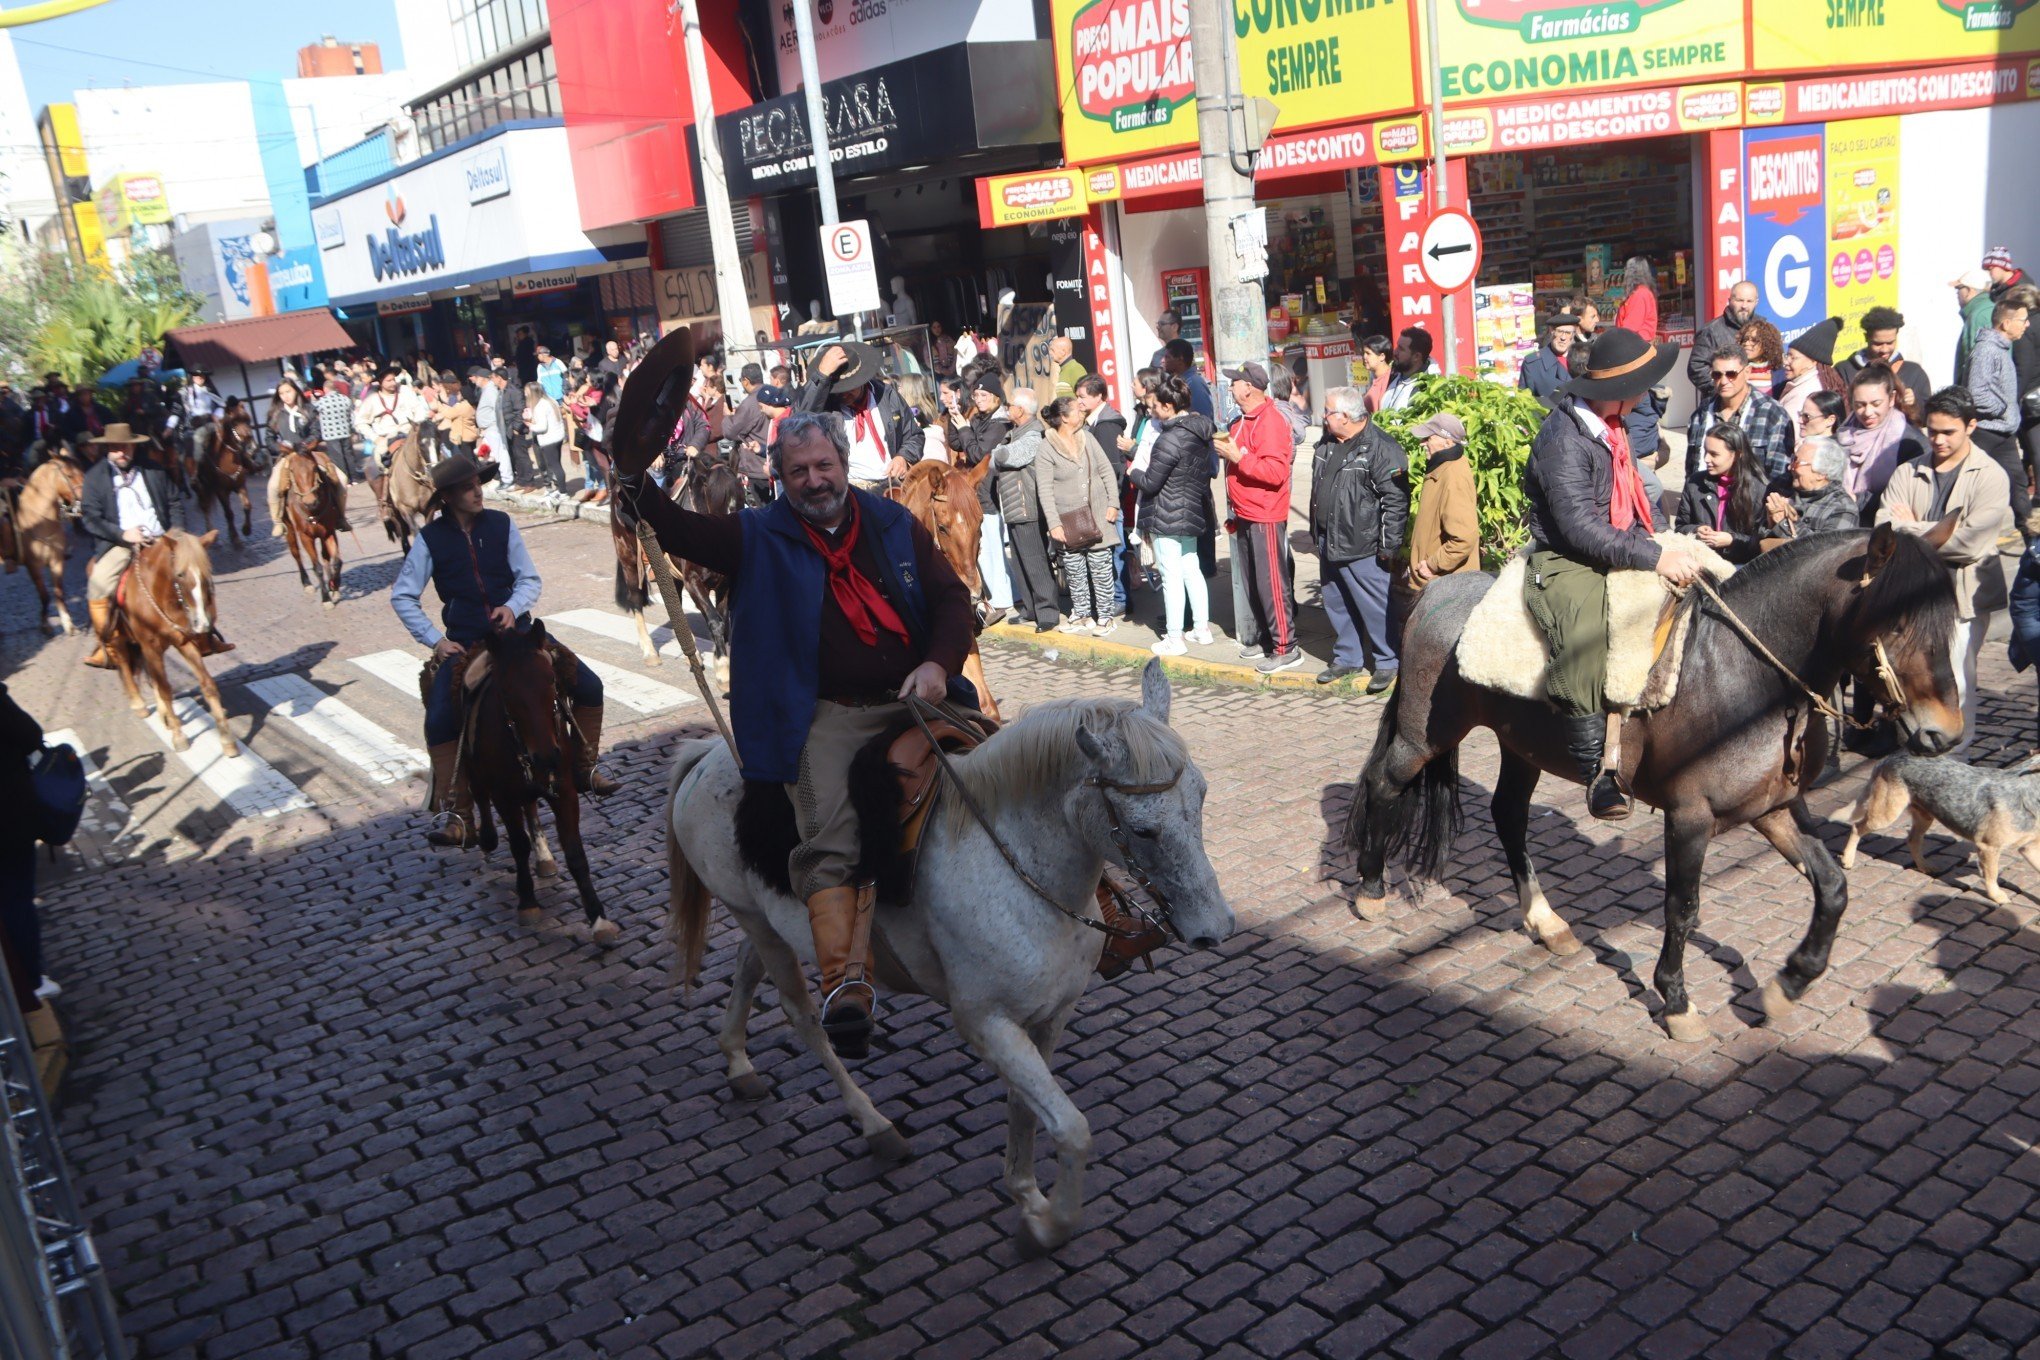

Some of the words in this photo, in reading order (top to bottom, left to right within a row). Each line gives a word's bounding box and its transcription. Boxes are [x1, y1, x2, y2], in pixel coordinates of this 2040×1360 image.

[849, 1, 887, 26] adidas
[1530, 8, 1630, 40] Farmácias
[1965, 4, 2012, 29] Farmácias
[780, 30, 799, 50] AER
[813, 25, 846, 41] IOLAÇÕES
[1076, 23, 1110, 59] PREÇO
[1109, 0, 1191, 55] MAIS
[1081, 40, 1195, 105] POPULAR
[1266, 36, 1342, 96] SEMPRE
[1440, 46, 1639, 97] ECONOMIA
[1642, 42, 1726, 70] SEMPRE
[1797, 76, 1918, 113] MEDICAMENTOS
[1917, 75, 1949, 102] COM
[1950, 67, 2018, 100] DESCONTO
[1114, 104, 1168, 131] Farmácias
[1496, 91, 1672, 127] MEDICAMENTOS
[1684, 101, 1738, 118] POPULAR
[1382, 135, 1418, 148] POPULAR
[1443, 129, 1487, 142] OPULAR
[1500, 125, 1550, 147] COM
[1553, 112, 1671, 142] DESCONTO
[1276, 131, 1366, 168] DESCONTO
[1830, 141, 1848, 155] FAÇA
[1849, 139, 1855, 152] O
[1855, 138, 1869, 151] SEU
[1869, 133, 1896, 150] CARTÃO
[752, 164, 782, 180] MODA
[782, 156, 809, 172] COM
[809, 148, 844, 168] MTO
[845, 137, 888, 160] ESTILO
[466, 158, 503, 192] Deltasul
[1024, 178, 1070, 194] MAIS
[1750, 149, 1820, 201] DESCONTOS
[1006, 188, 1073, 206] POPULAR
[1003, 207, 1055, 221] ECONOMIA
[366, 213, 446, 283] Deltasul
[839, 233, 854, 255] E
[528, 272, 576, 291] Deltasul
[1764, 233, 1812, 319] G
[391, 297, 431, 313] Deltasul
[1323, 342, 1352, 357] OFERTA
